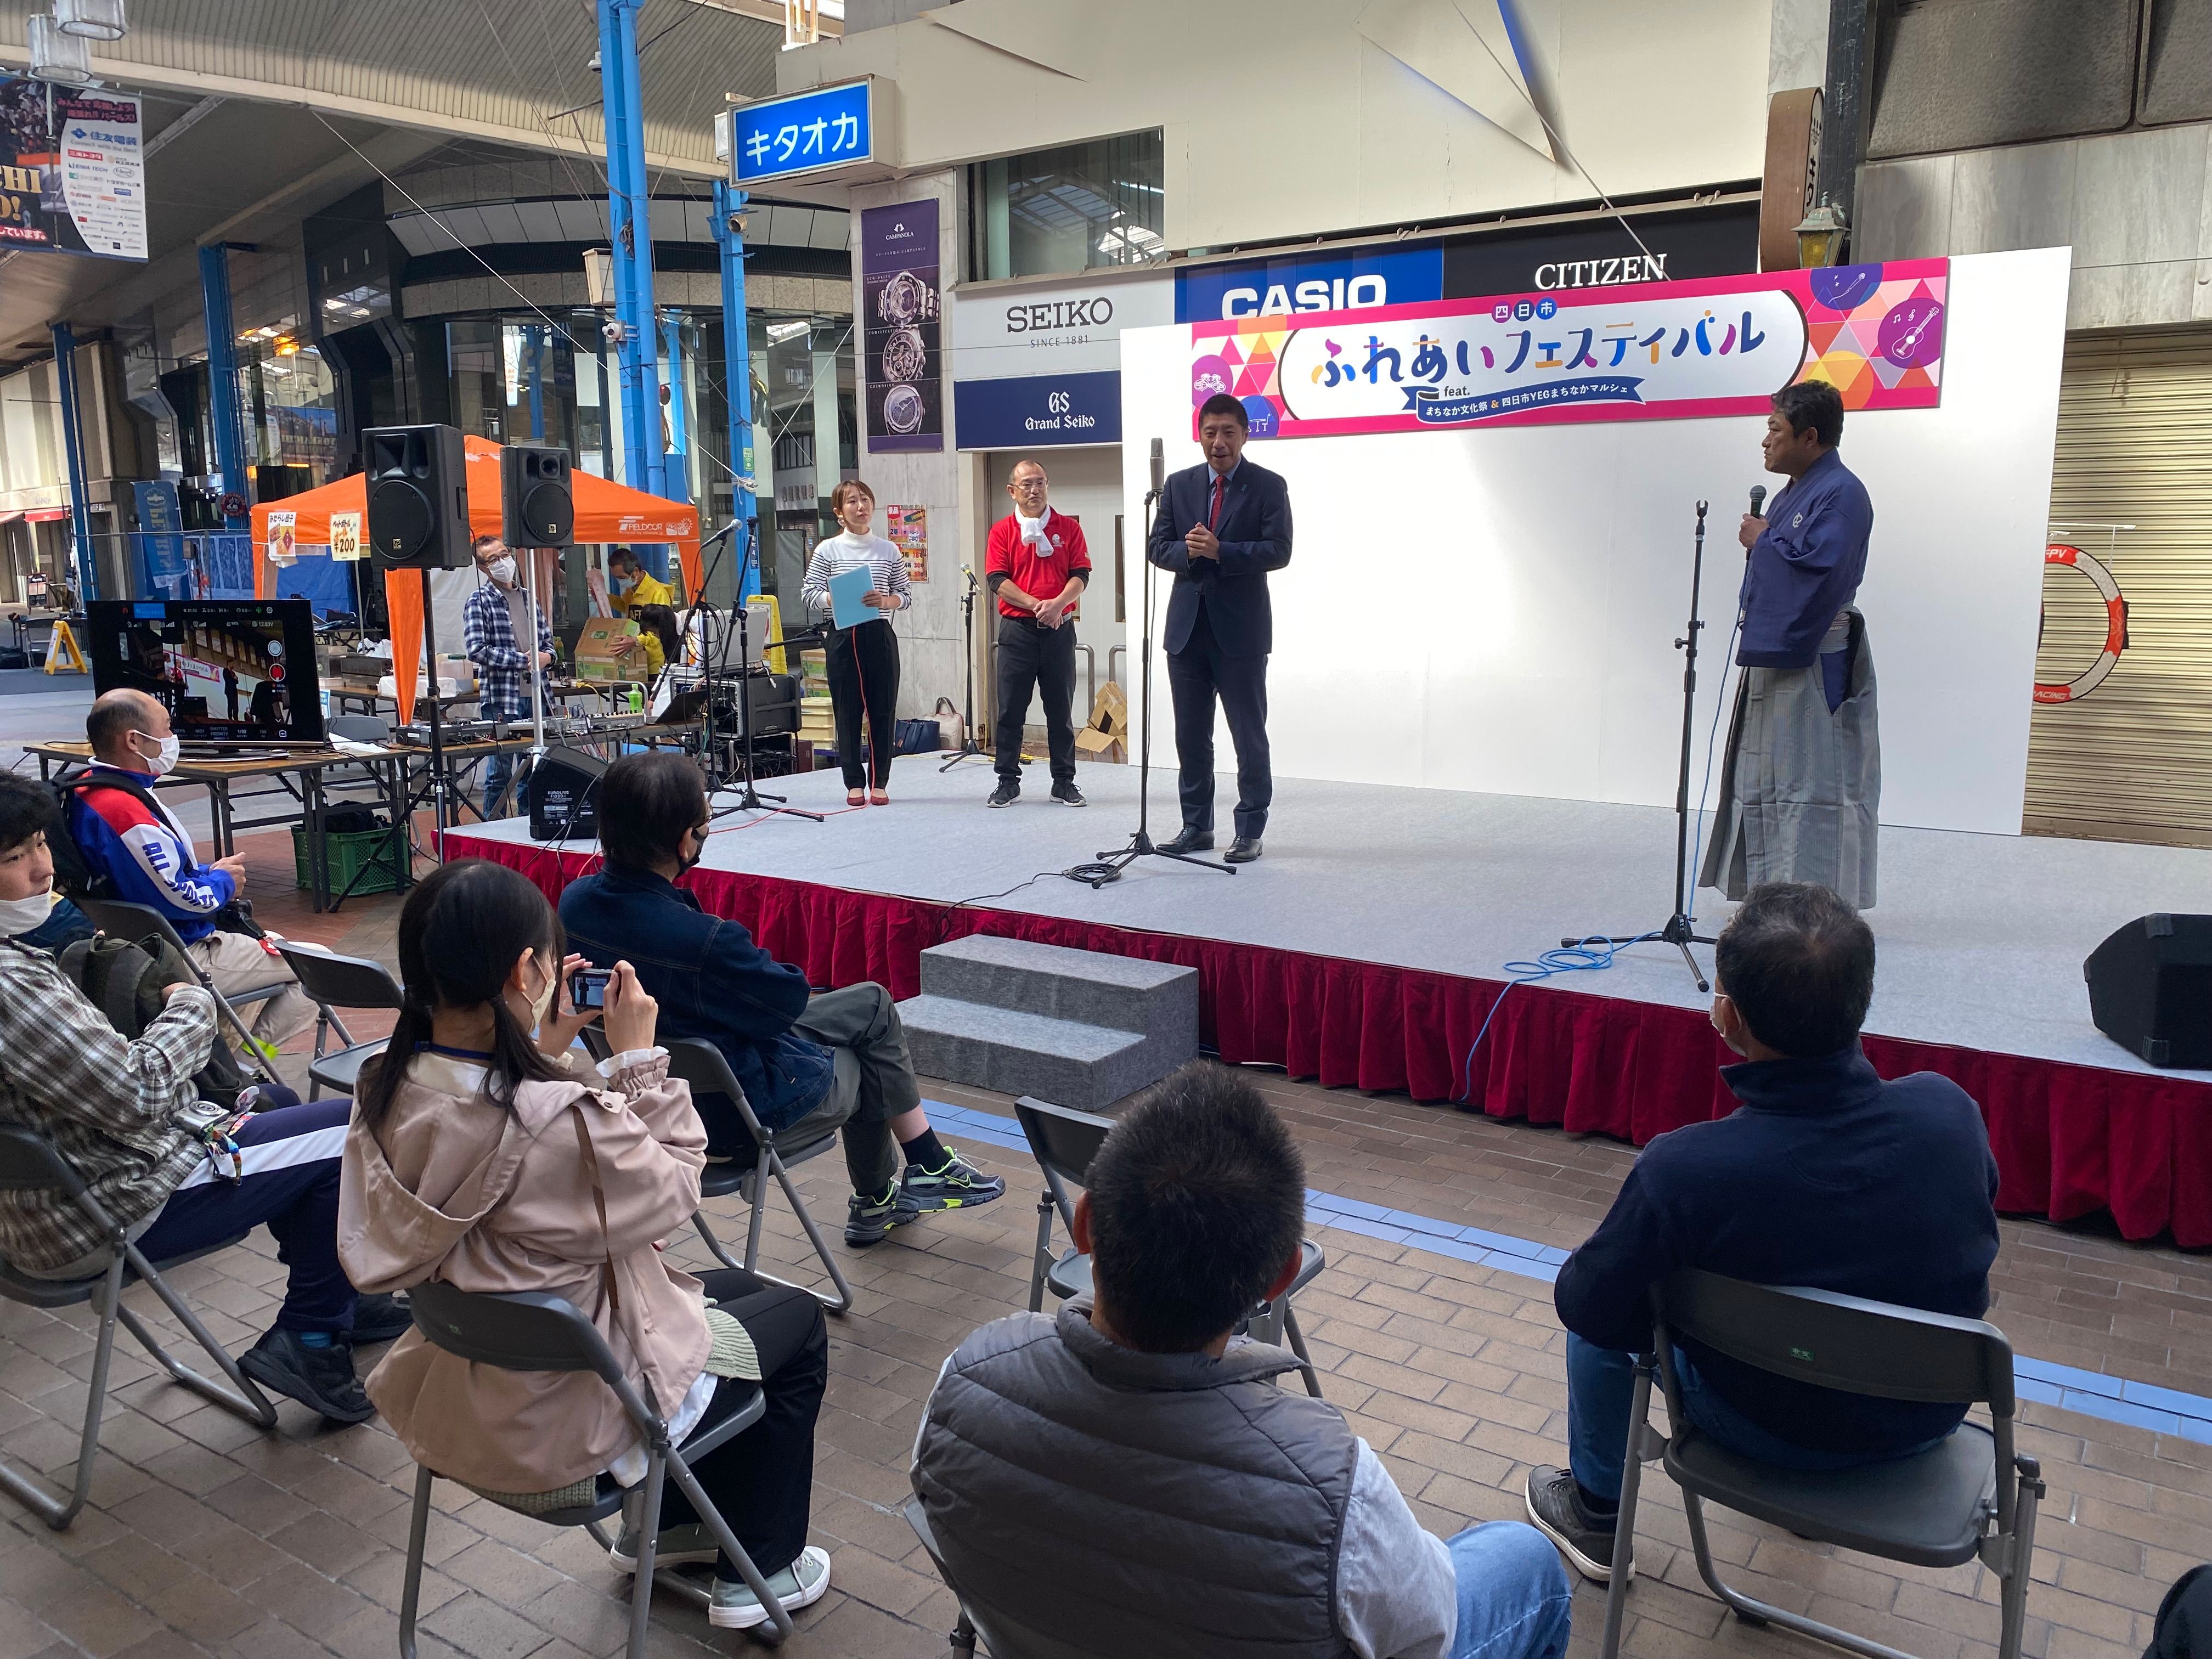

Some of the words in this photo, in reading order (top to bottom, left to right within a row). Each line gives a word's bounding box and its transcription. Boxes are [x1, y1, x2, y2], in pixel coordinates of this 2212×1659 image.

[747, 111, 857, 166] キタオカ
[0, 165, 42, 193] HI
[885, 232, 914, 240] CAMPANOLA
[1534, 253, 1667, 290] CITIZEN
[1222, 274, 1386, 320] CASIO
[1495, 301, 1553, 320] 四日市
[1007, 297, 1113, 332] SEIKO
[1030, 337, 1060, 348] SINCE
[1066, 335, 1088, 345] 1881
[1311, 309, 1765, 387] ふれあいフェスティバル
[1048, 392, 1069, 413] GS
[1426, 402, 1487, 416] まちなか文化祭
[1491, 400, 1499, 409] &
[1502, 383, 1628, 407] 四日市YEGまちなかマルシェ
[1444, 386, 1470, 397] feat.
[1025, 416, 1060, 430] Grand
[1063, 414, 1095, 428] Seiko
[269, 514, 294, 523] みたらし団子
[142, 842, 170, 874] ALL
